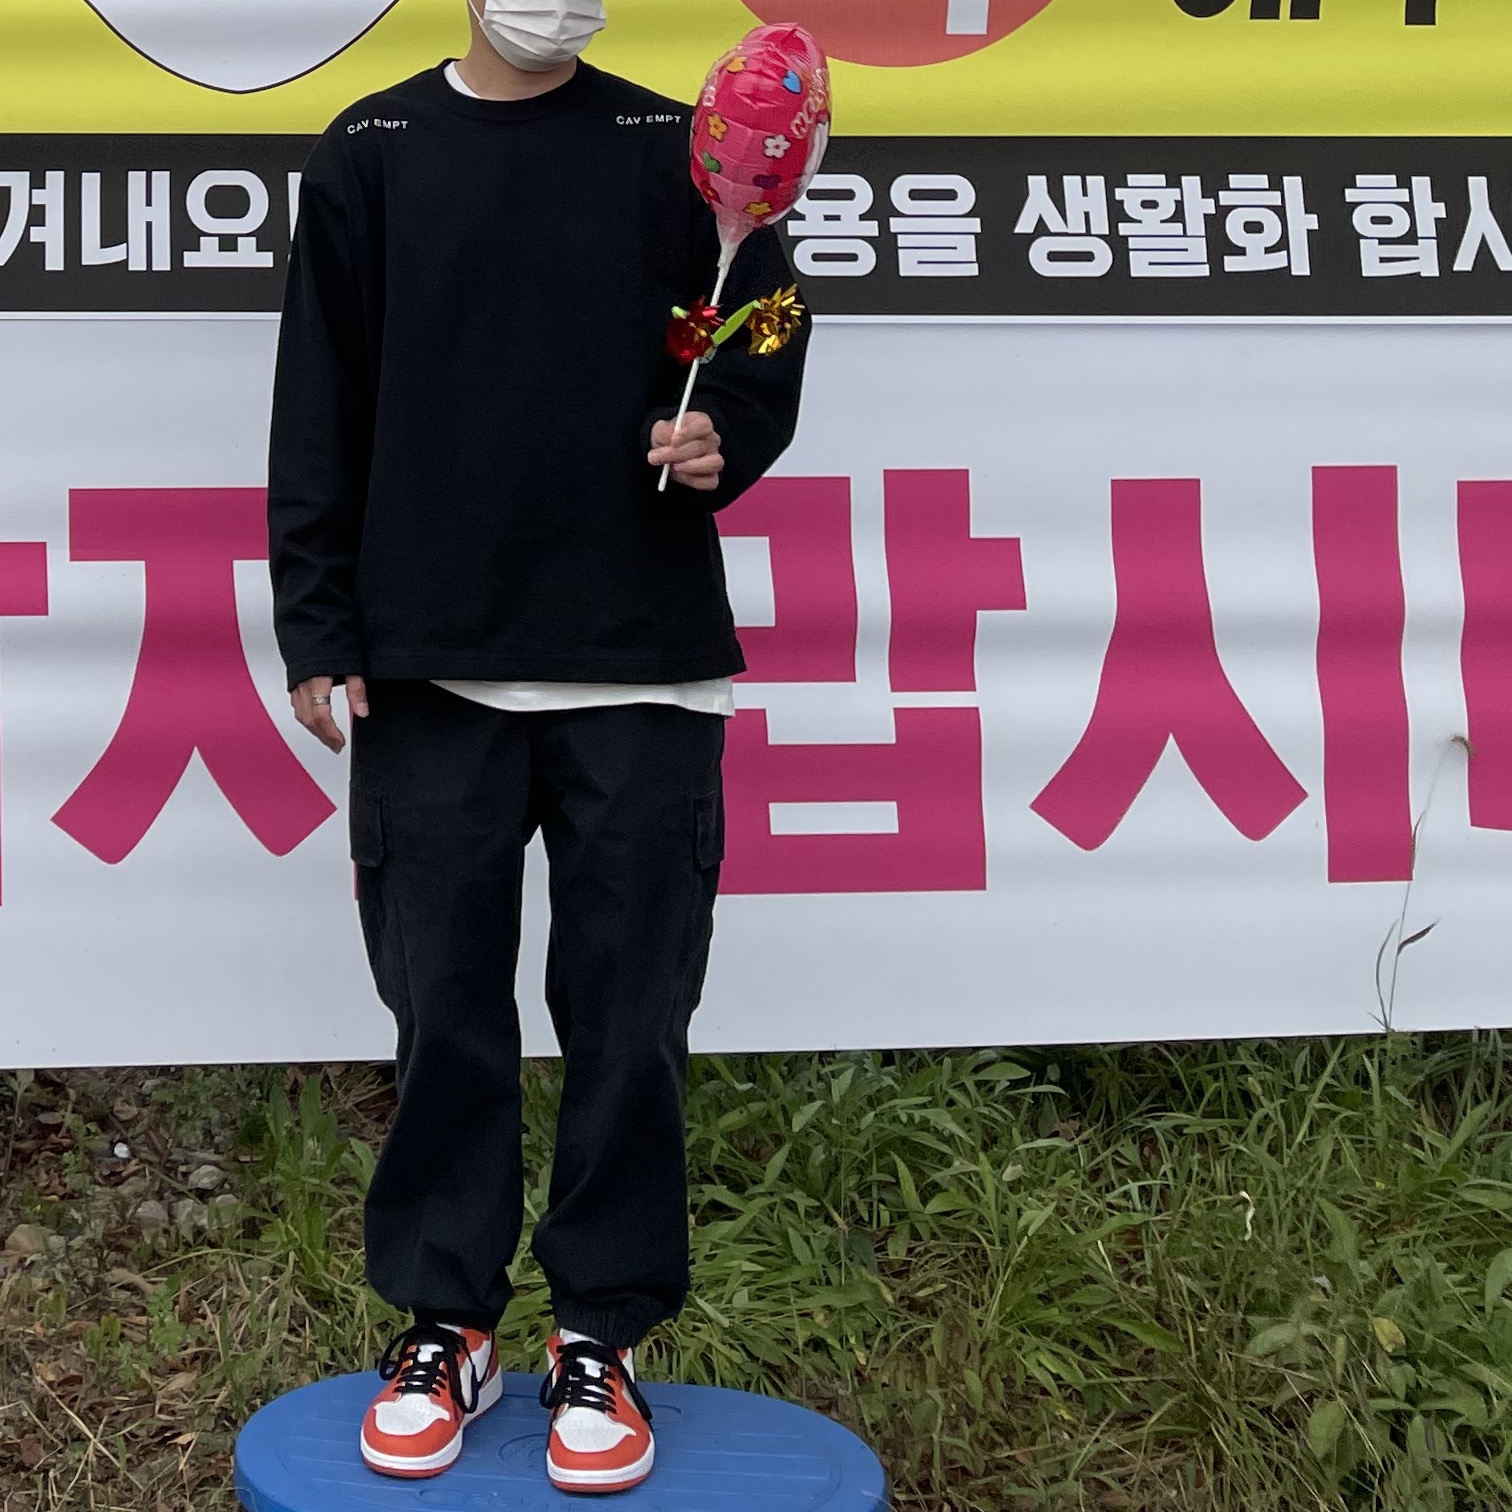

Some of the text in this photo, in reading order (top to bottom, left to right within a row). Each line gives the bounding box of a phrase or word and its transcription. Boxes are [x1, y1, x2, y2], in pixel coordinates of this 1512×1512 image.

[347, 119, 369, 135] CAV
[616, 114, 681, 125] CAV EMPT
[788, 173, 981, 277] 용을
[1014, 174, 1319, 278] 생활화
